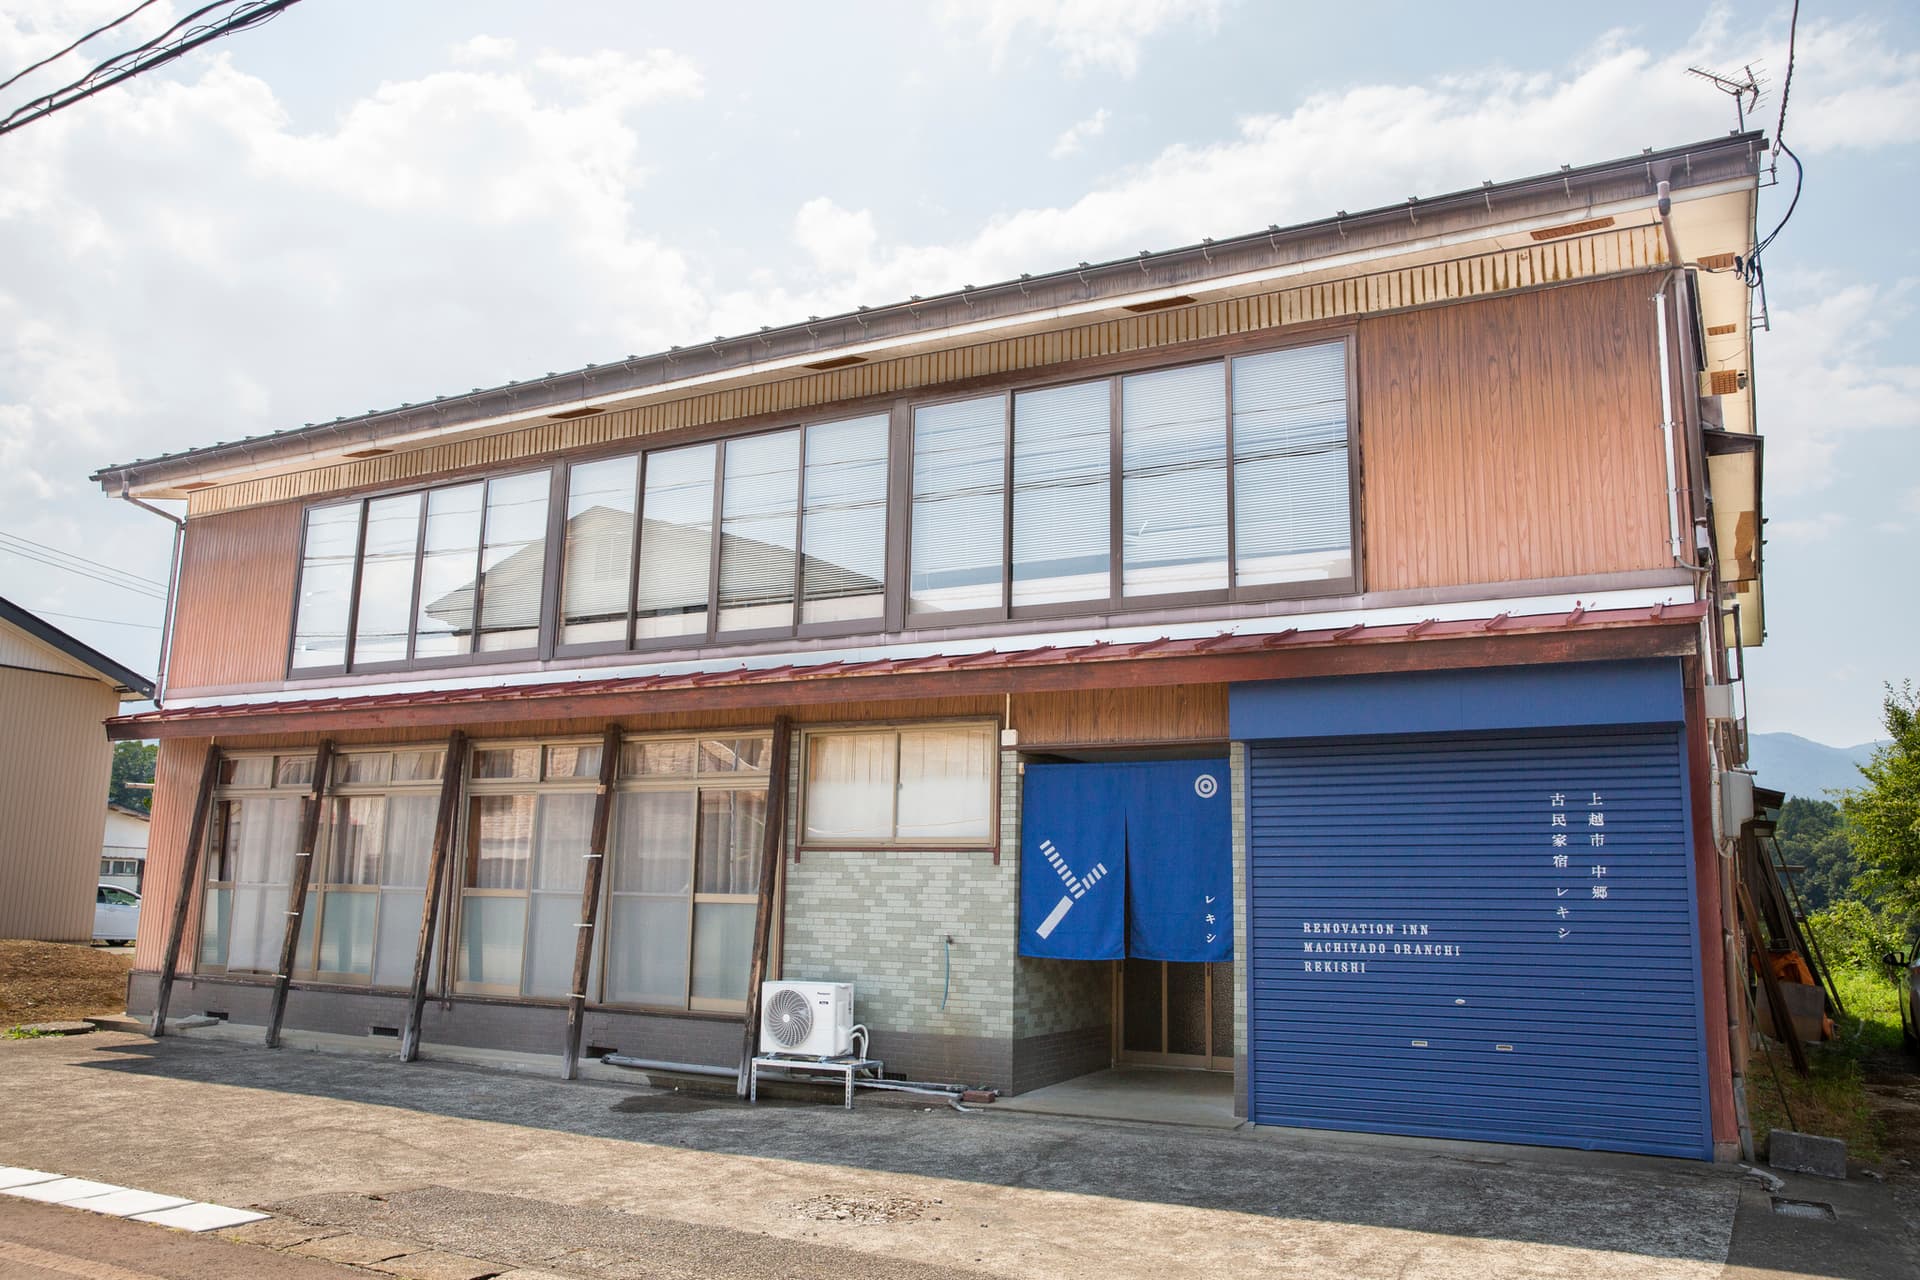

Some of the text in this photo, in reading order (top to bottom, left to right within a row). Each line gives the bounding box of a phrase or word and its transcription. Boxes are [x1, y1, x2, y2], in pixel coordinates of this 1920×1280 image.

[1587, 792, 1608, 900] 上越市 中郷
[1549, 792, 1571, 939] 古民家宿 レキシ
[1205, 895, 1217, 944] レキシ
[1303, 922, 1429, 936] RENOVATION INN
[1303, 942, 1461, 957] MACHIYADO ORANCHI
[1303, 960, 1366, 974] REKISHI
